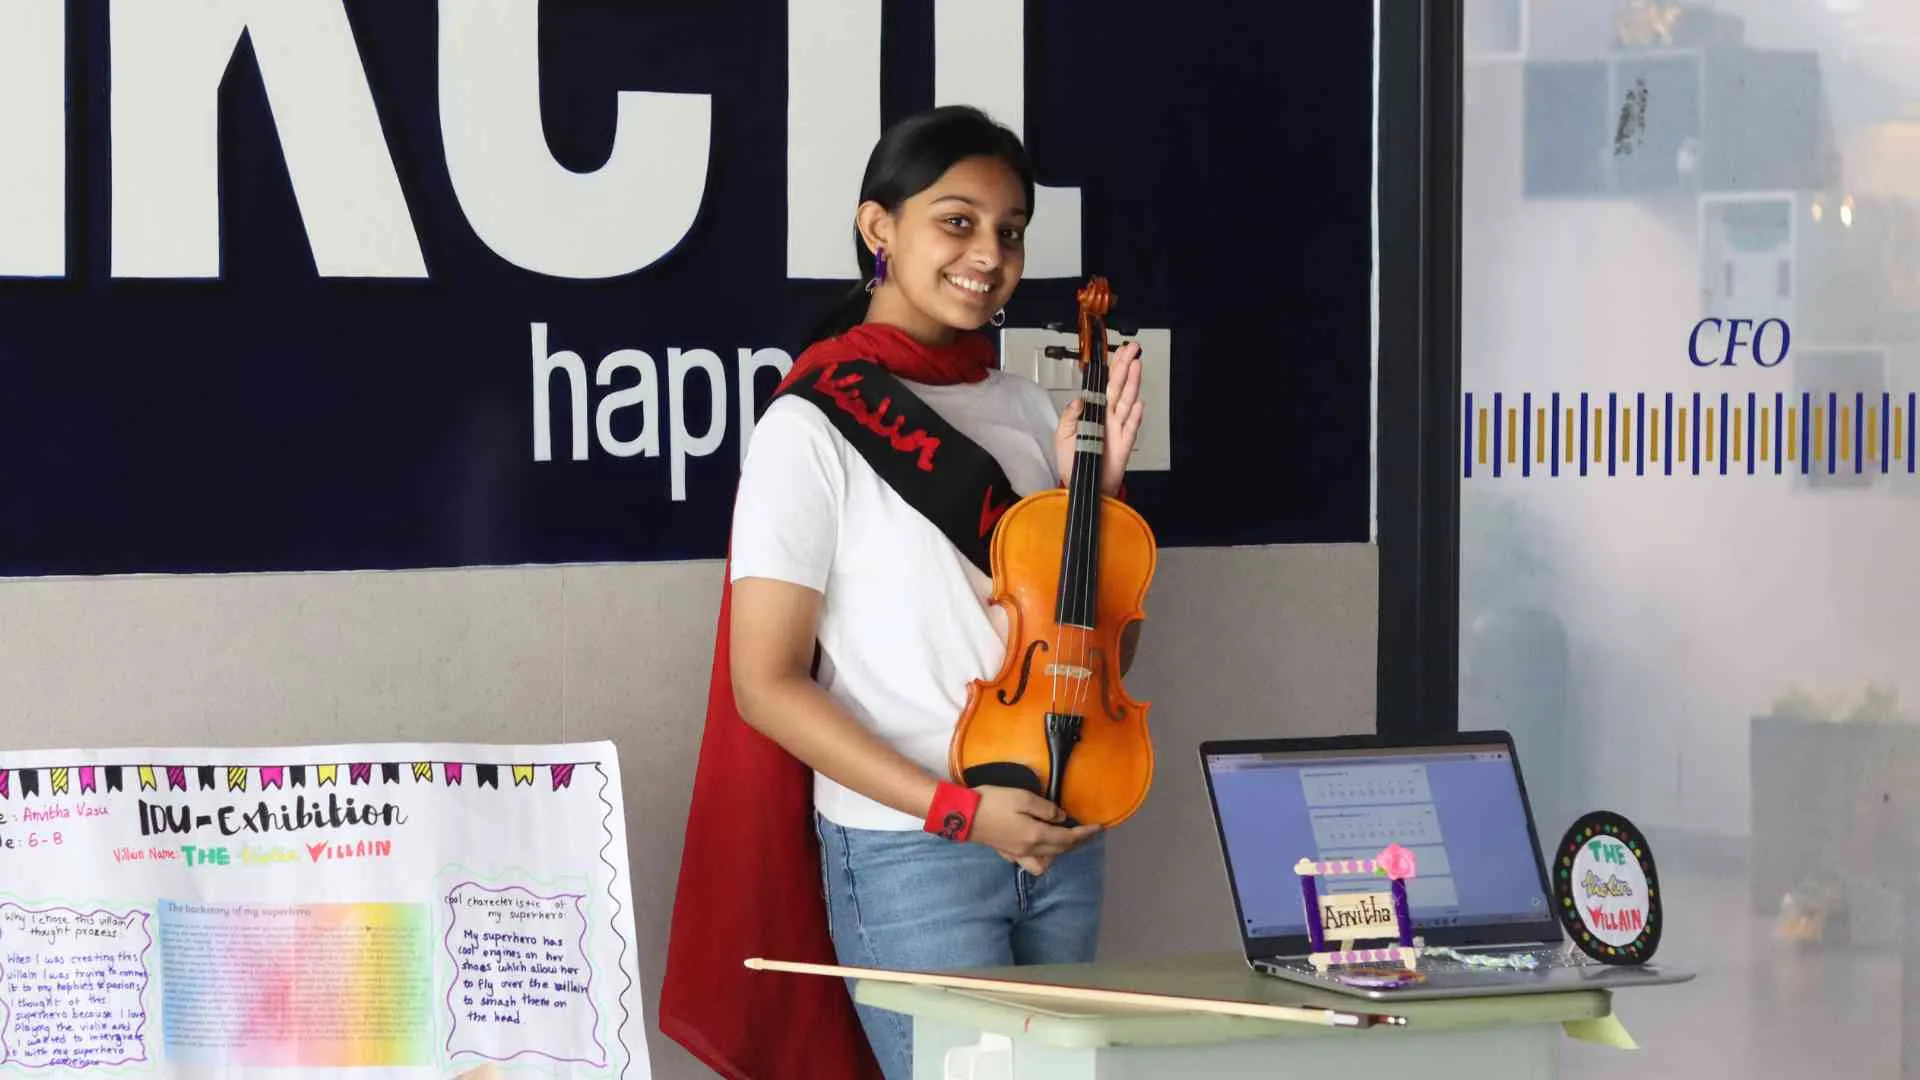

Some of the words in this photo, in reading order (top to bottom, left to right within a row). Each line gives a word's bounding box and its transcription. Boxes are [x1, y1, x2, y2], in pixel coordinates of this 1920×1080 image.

[1688, 317, 1791, 368] CFO
[23, 802, 71, 822] Anvitha
[76, 802, 110, 817] Vasu
[180, 845, 230, 866] THE
[305, 840, 391, 863] VILLAIN
[1588, 840, 1626, 865] THE
[1323, 896, 1391, 930] Anvitha
[1587, 905, 1642, 931] VILLAIN
[464, 930, 479, 949] My
[483, 931, 537, 947] superhero
[544, 936, 563, 947] has
[483, 949, 521, 964] engines
[525, 951, 538, 959] on
[546, 951, 563, 961] her
[462, 959, 492, 972] shoes
[498, 961, 526, 973] which
[530, 963, 557, 973] allow
[561, 965, 580, 975] her
[464, 979, 474, 988] to
[478, 979, 494, 997] fly
[501, 980, 523, 989] over
[529, 978, 549, 989] the
[464, 995, 473, 1005] to
[480, 994, 516, 1007] smash
[553, 1000, 567, 1009] on
[467, 1010, 487, 1022] the
